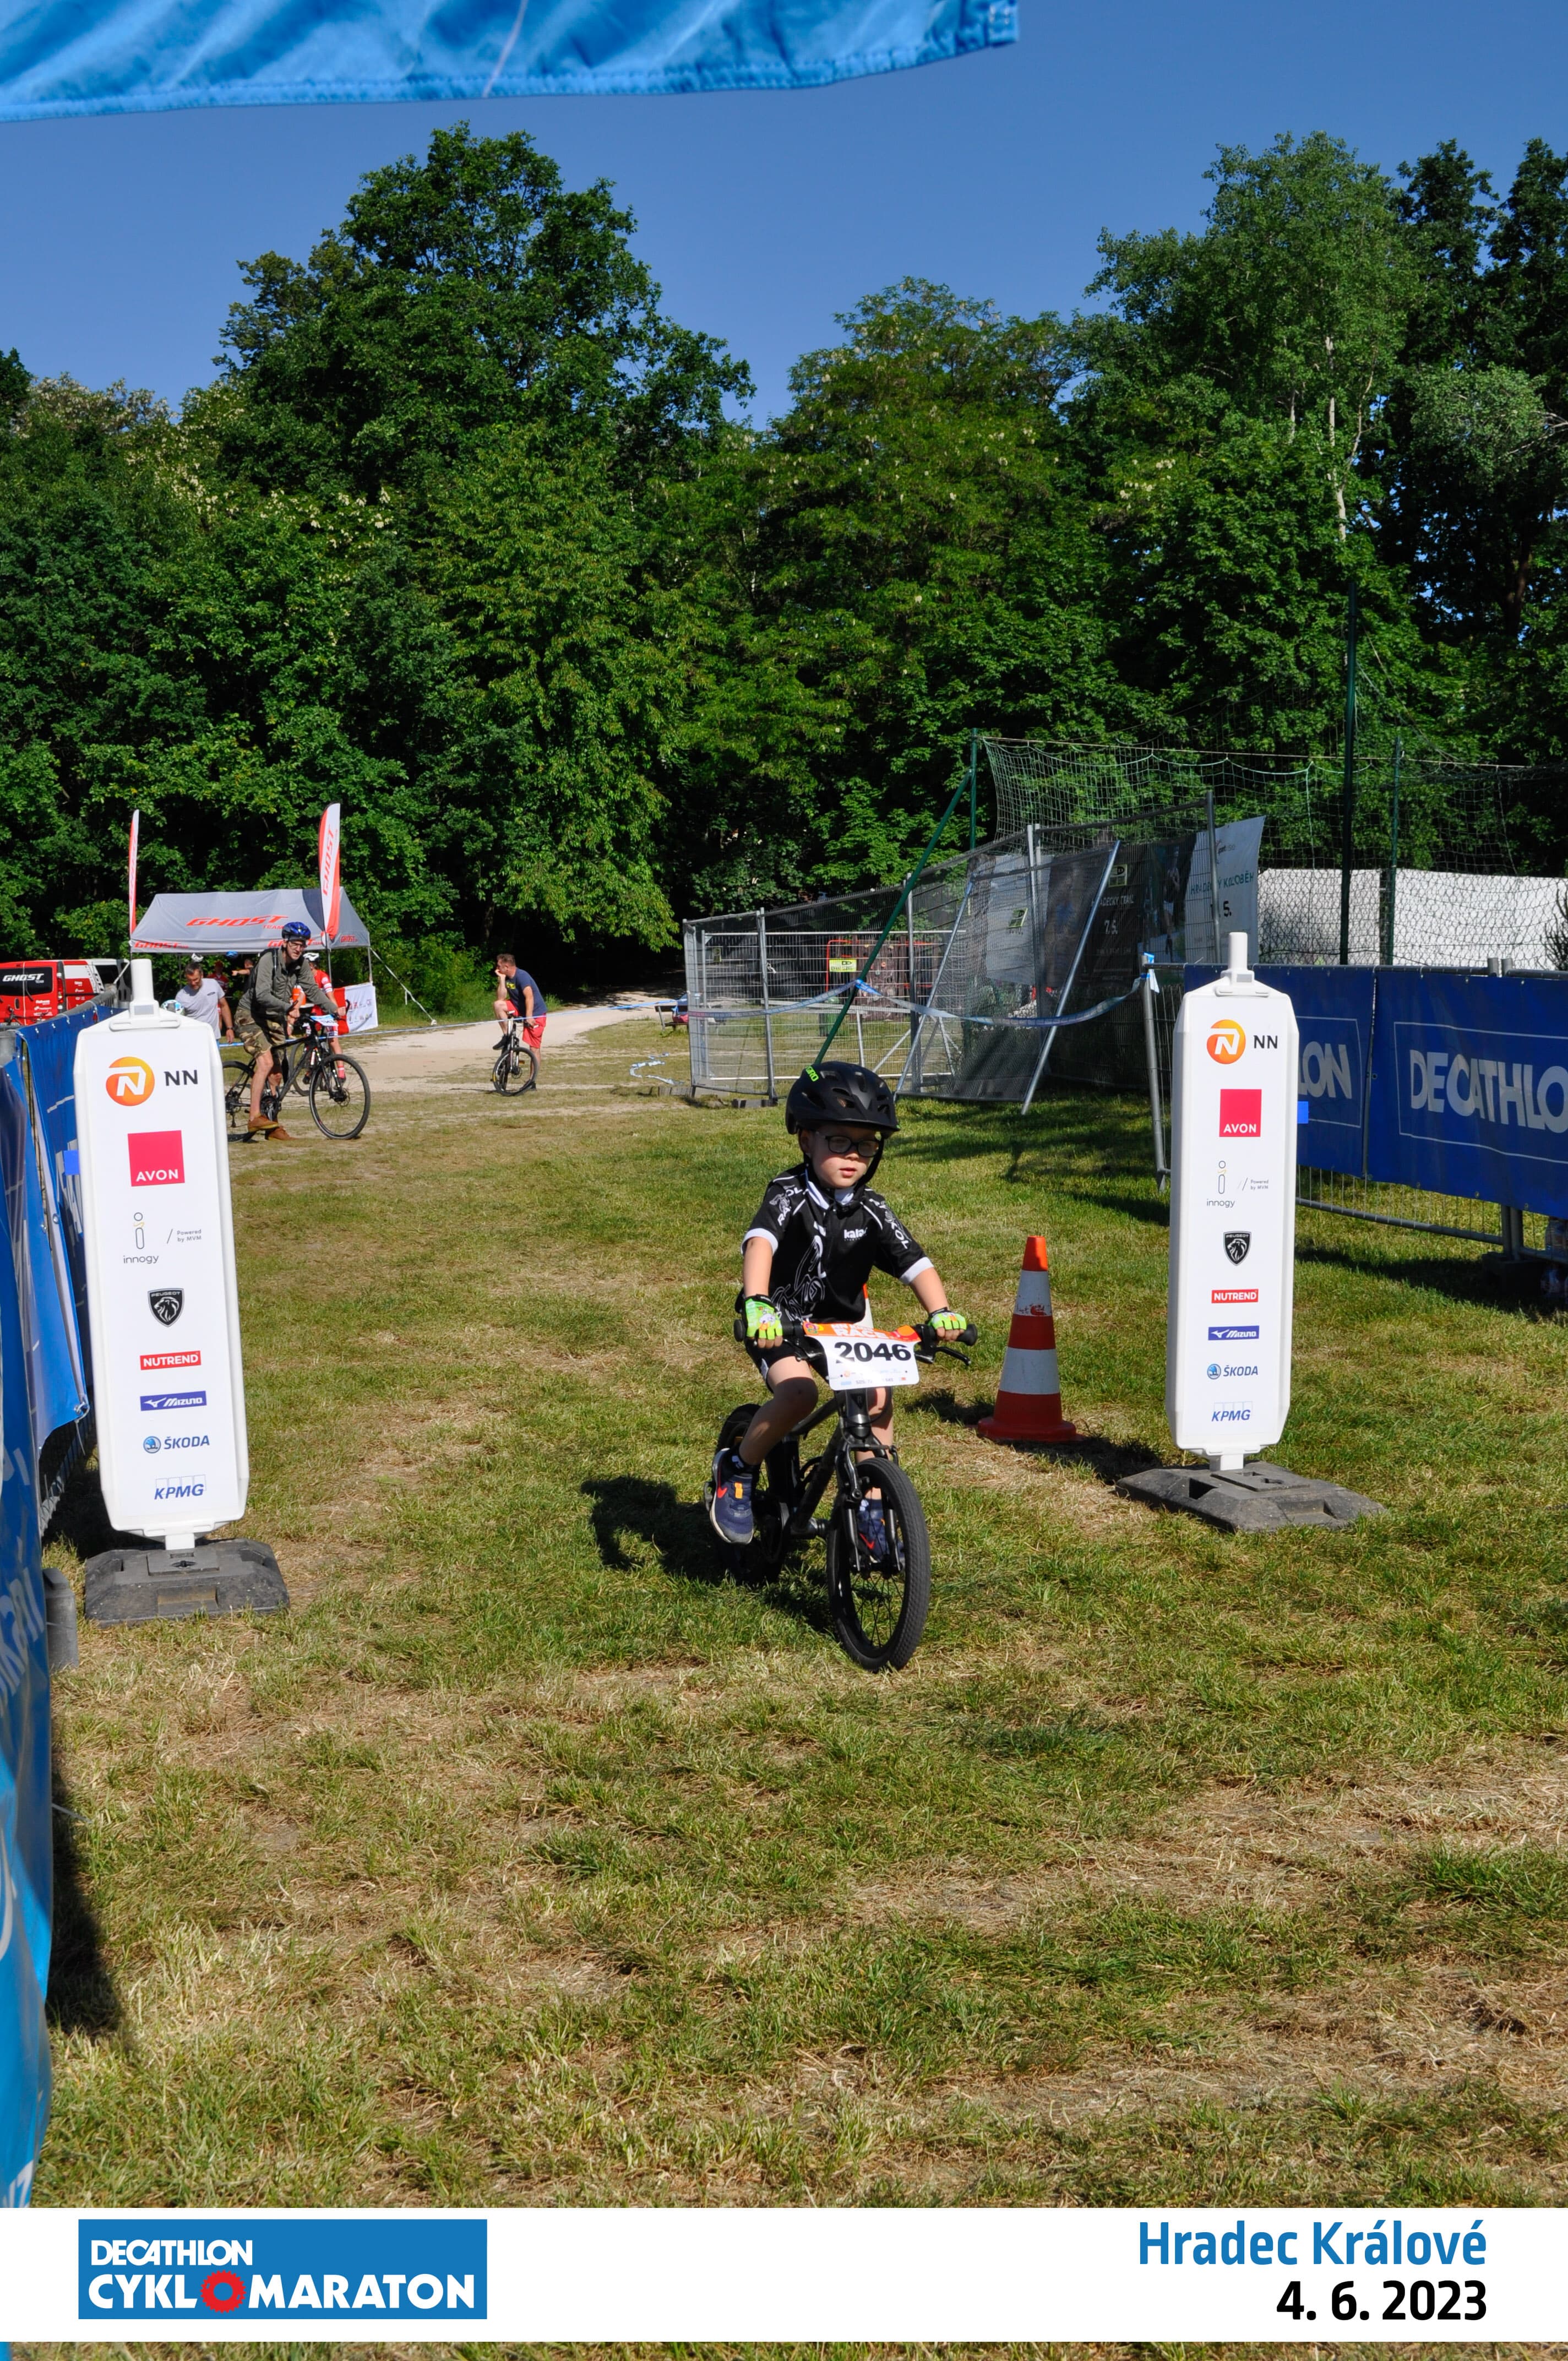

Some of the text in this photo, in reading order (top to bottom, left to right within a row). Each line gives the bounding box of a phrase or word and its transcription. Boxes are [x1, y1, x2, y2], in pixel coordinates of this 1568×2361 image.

[186, 915, 288, 926] GHOST
[3, 973, 44, 982] GHOST
[1253, 1035, 1278, 1049] NN
[164, 1069, 198, 1086] NN
[1223, 1124, 1257, 1133] AVON
[136, 1168, 178, 1182] AVON
[1206, 1199, 1235, 1208] innogy
[123, 1255, 160, 1264] innogy
[1213, 1291, 1257, 1301] NUTREND
[834, 1342, 911, 1364] 2046
[143, 1353, 199, 1367] NUTREND
[1223, 1364, 1258, 1377] ŠKODA
[1211, 1409, 1251, 1422] KPMG
[164, 1435, 210, 1450] ŠKODA
[154, 1483, 204, 1500] KPMG
